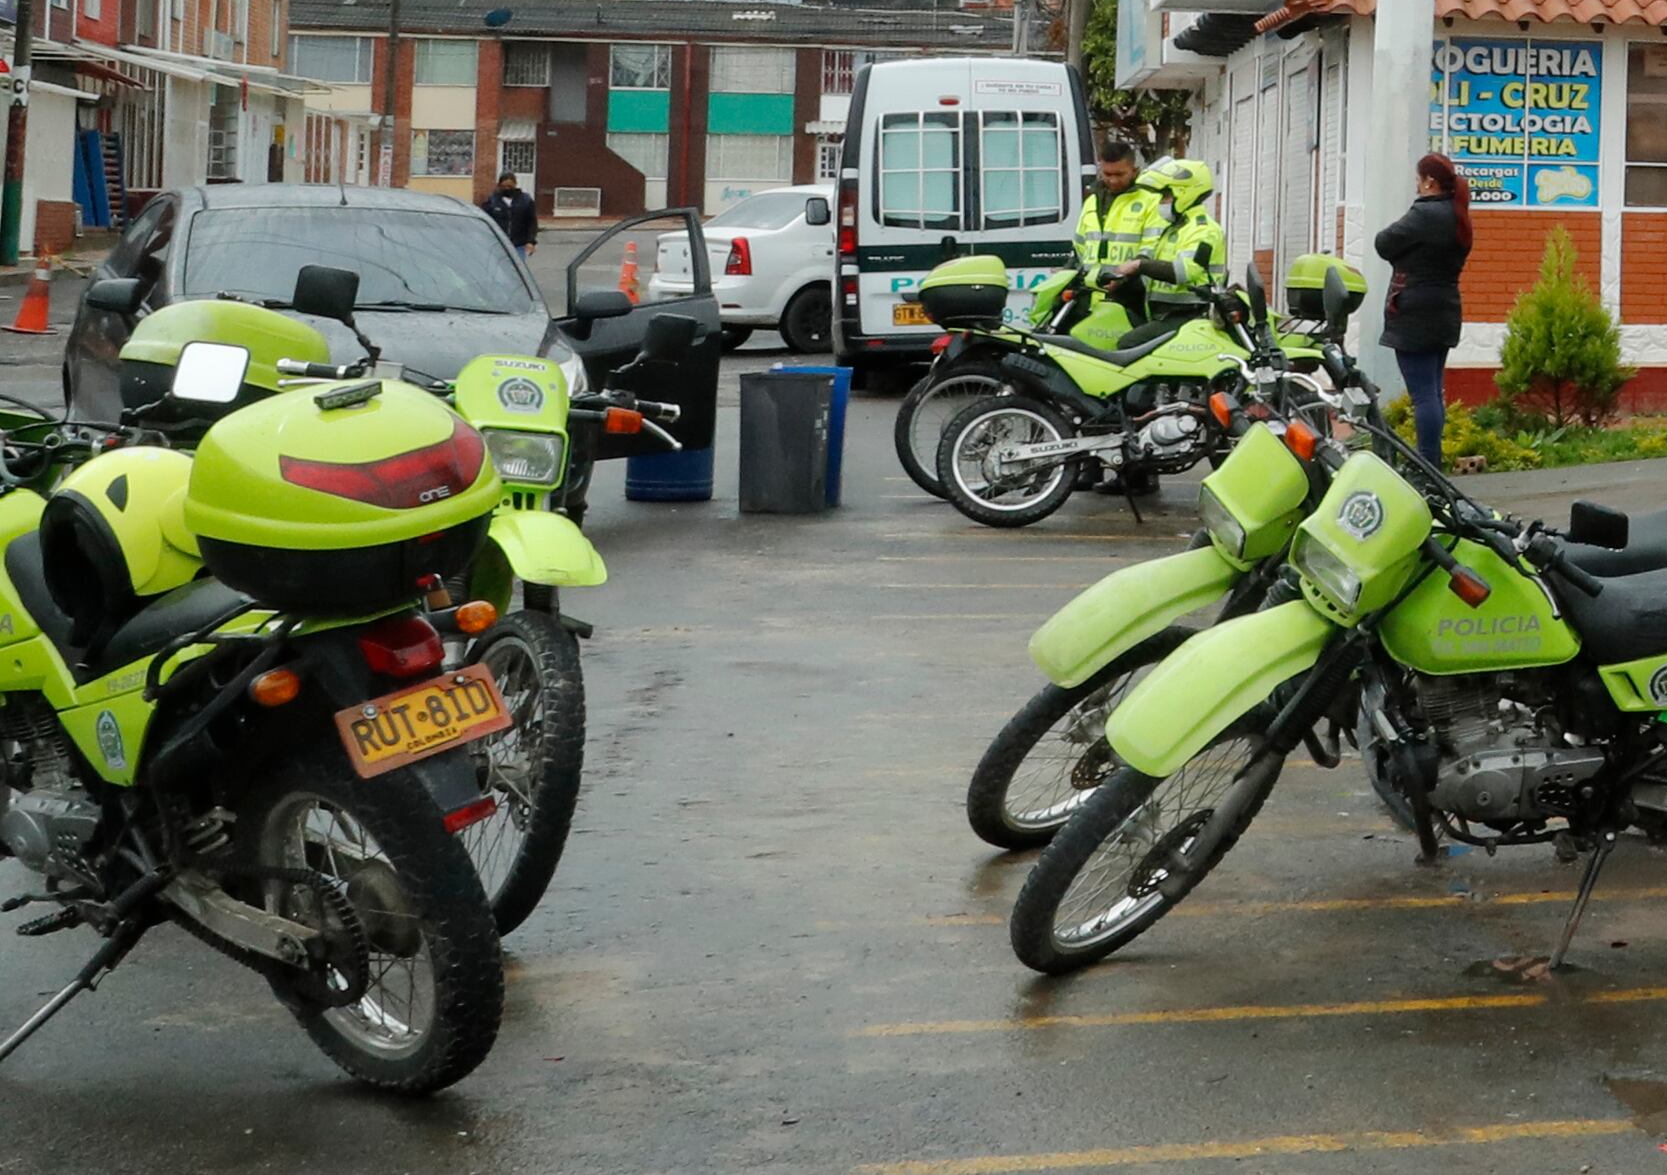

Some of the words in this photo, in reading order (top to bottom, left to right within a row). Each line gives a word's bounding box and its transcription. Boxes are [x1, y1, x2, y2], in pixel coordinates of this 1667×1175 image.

[1434, 46, 1597, 76] OGUERIA
[1502, 82, 1589, 109] CRUZ
[1428, 135, 1577, 155] RFUMERIA
[1168, 343, 1217, 353] POLICIA
[495, 360, 546, 371] SUZUKI
[1030, 441, 1079, 454] SUZUKI
[1437, 615, 1541, 637] POLICIA
[351, 704, 416, 756] RUT
[406, 726, 458, 750] COLOMBIA
